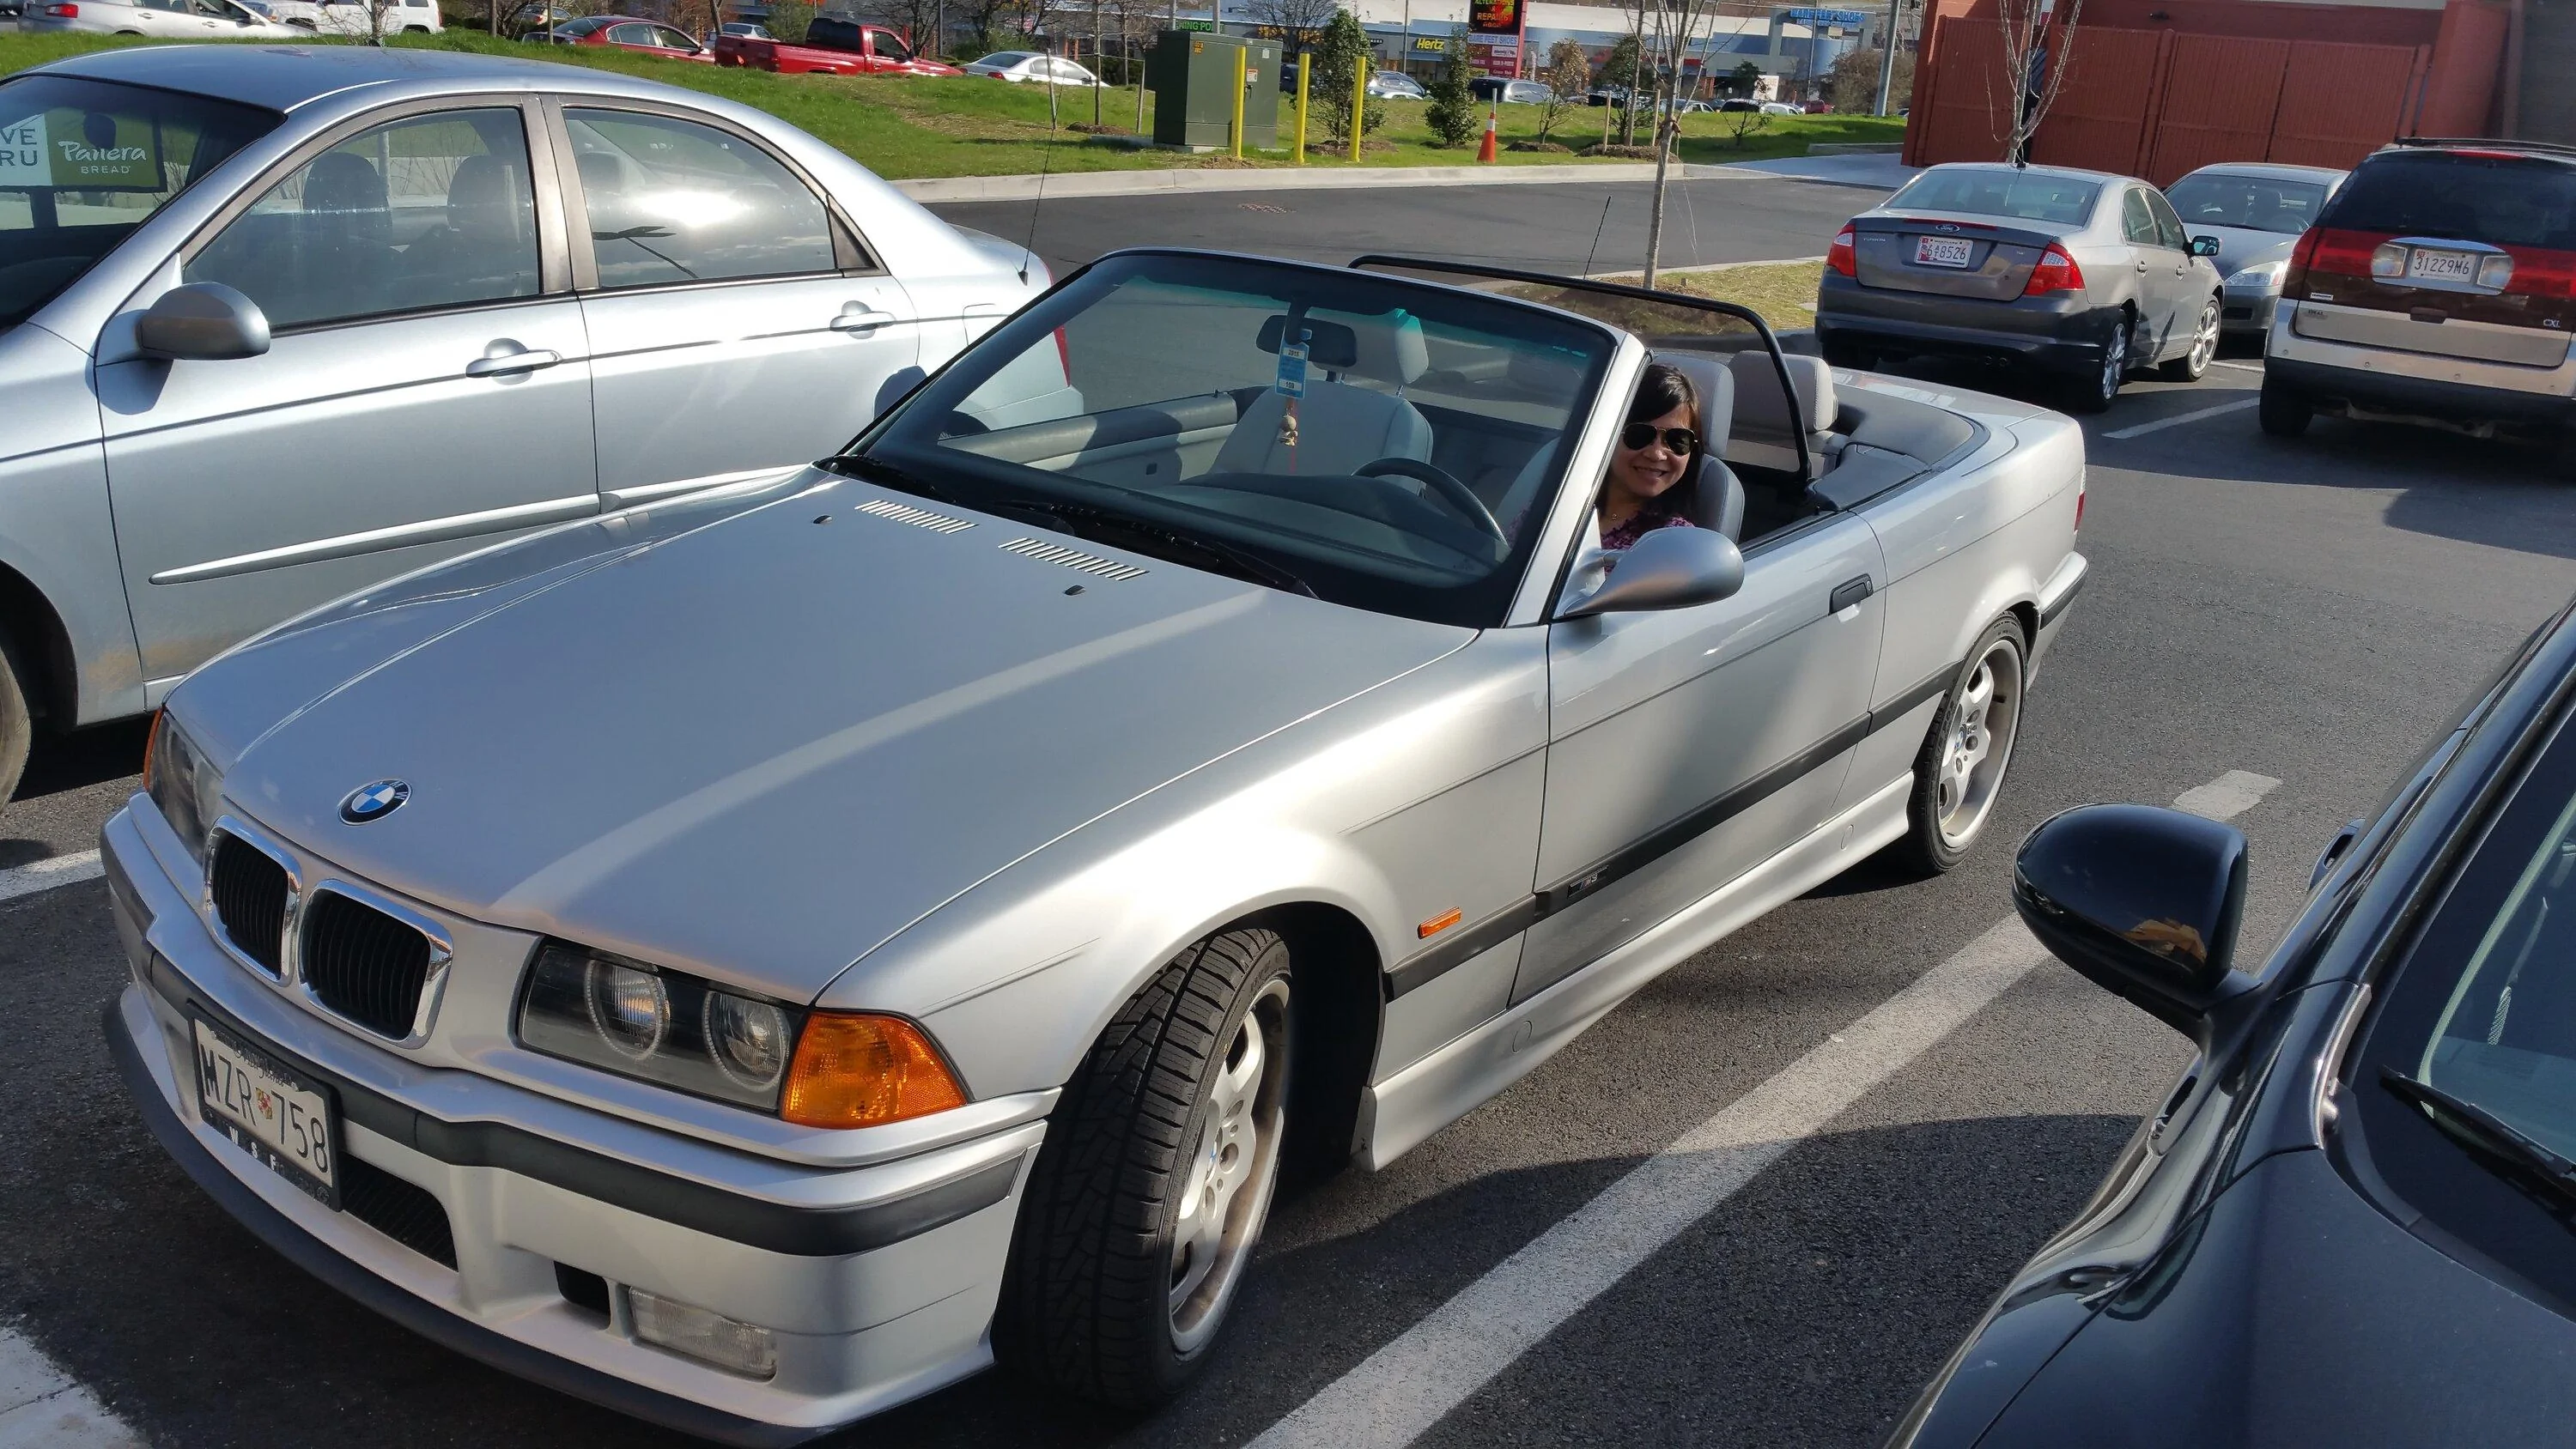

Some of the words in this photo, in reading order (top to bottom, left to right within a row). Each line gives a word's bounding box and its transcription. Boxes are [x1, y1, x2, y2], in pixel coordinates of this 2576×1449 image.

[1416, 37, 1445, 50] Hertz
[58, 140, 147, 161] Panera
[81, 166, 130, 174] BREAD
[2414, 257, 2470, 275] 31229M6
[199, 1043, 257, 1127] MZR
[270, 1089, 328, 1173] 758
